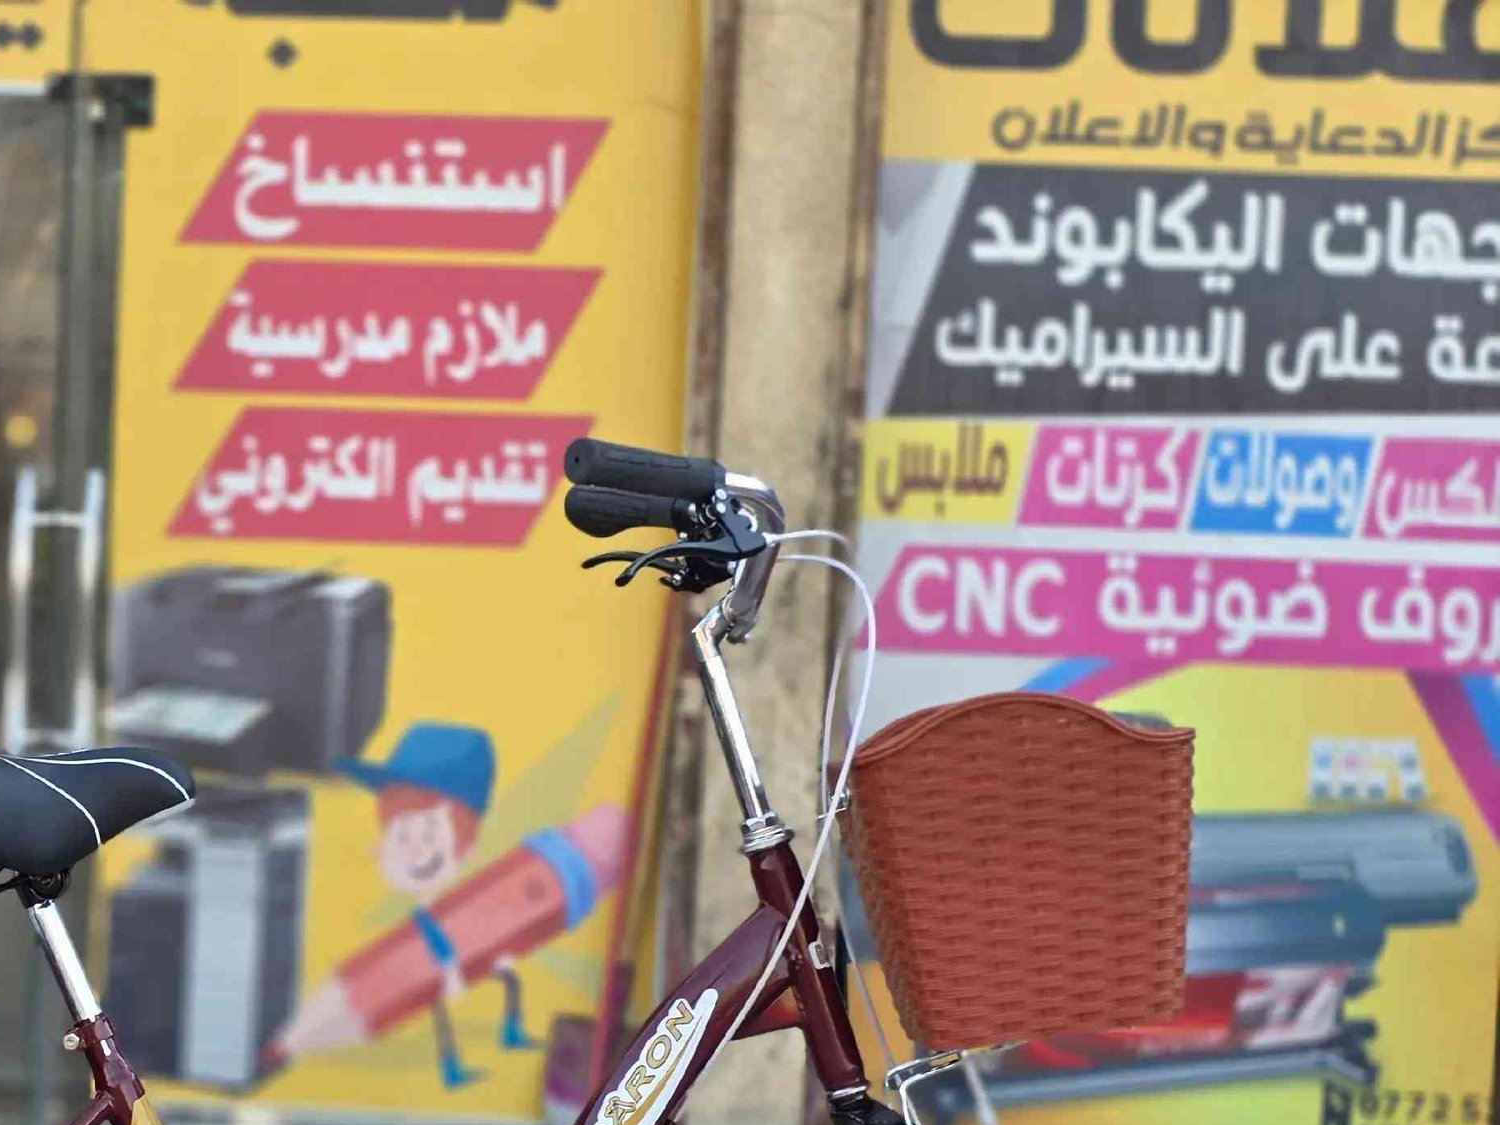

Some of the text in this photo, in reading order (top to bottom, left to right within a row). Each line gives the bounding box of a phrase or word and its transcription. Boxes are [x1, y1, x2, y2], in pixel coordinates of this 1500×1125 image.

[234, 134, 567, 239] استنساخ
[227, 292, 548, 384] ملازم مدرسية
[934, 299, 1246, 390] السيراميك
[1265, 313, 1402, 392] على
[195, 435, 549, 535] تقديم الكتروني
[874, 421, 1010, 517] ملابس
[1206, 432, 1360, 529] وصولات
[897, 555, 1067, 637] CNC
